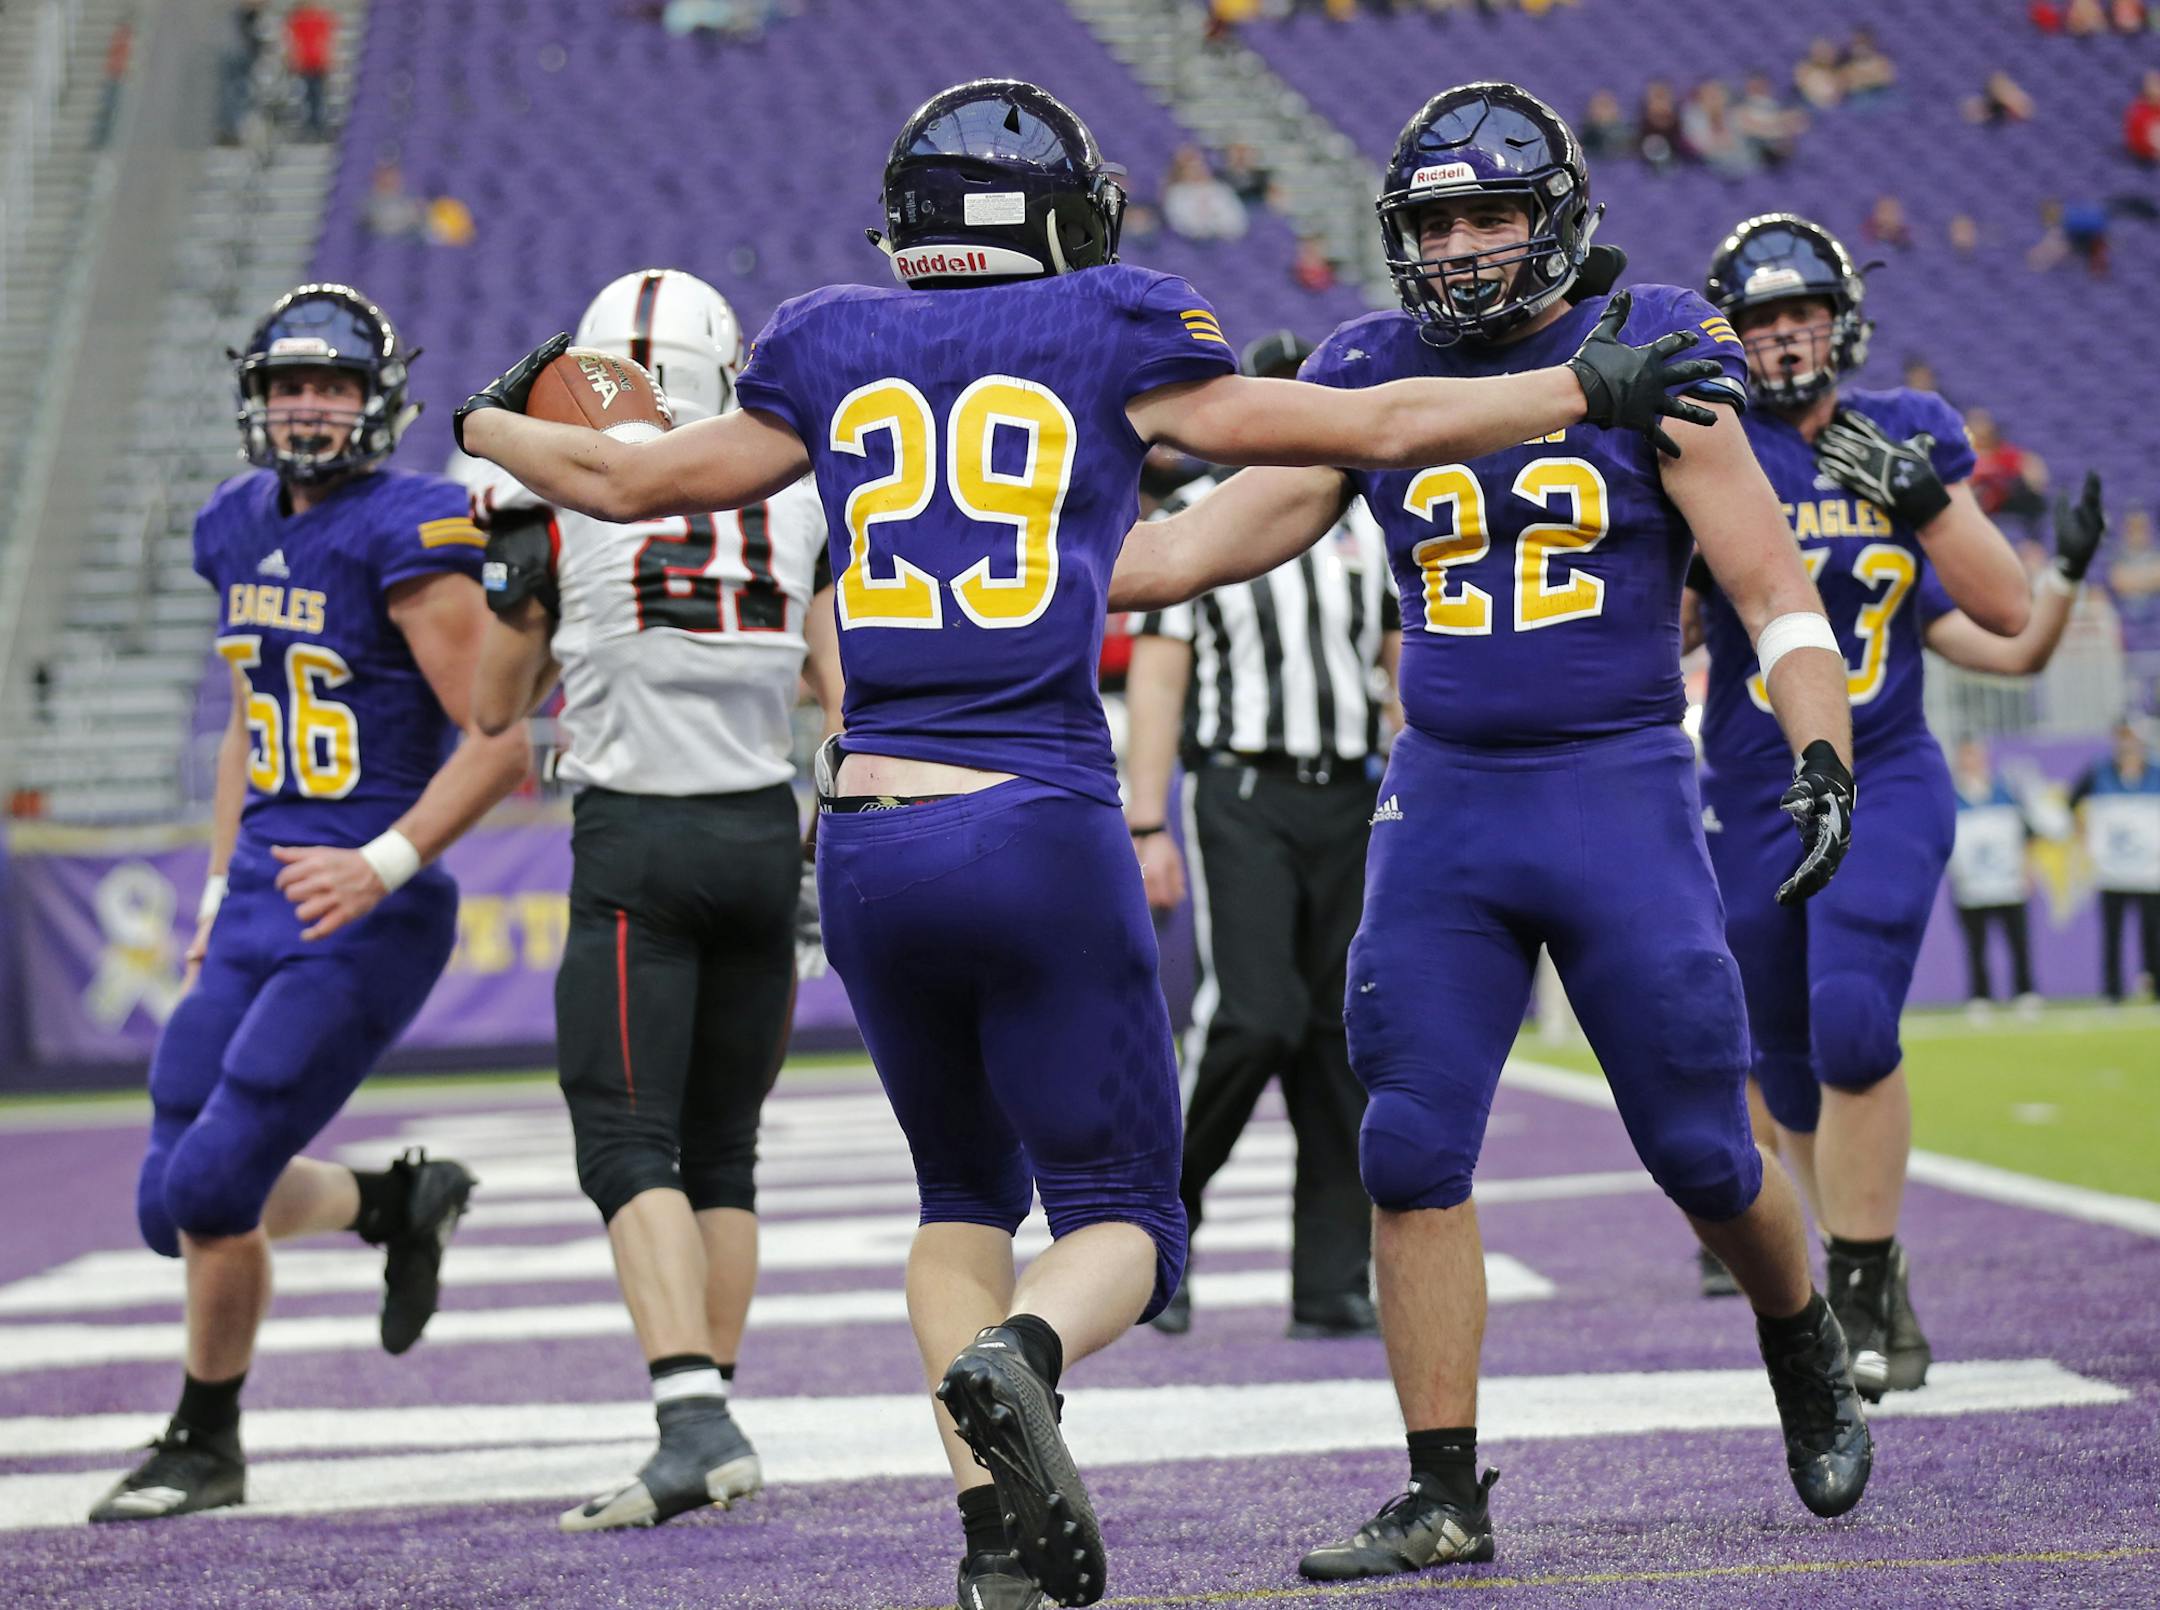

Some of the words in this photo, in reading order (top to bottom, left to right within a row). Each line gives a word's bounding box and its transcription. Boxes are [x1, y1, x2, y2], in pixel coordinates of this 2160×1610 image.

[1417, 167, 1465, 183] Riddell
[897, 252, 988, 279] Riddell
[632, 499, 787, 633] 21
[830, 373, 1078, 631] 29
[1403, 457, 1609, 635] 22
[228, 583, 327, 635] EAGLES
[1745, 543, 1917, 714] 3
[214, 634, 362, 800] 56
